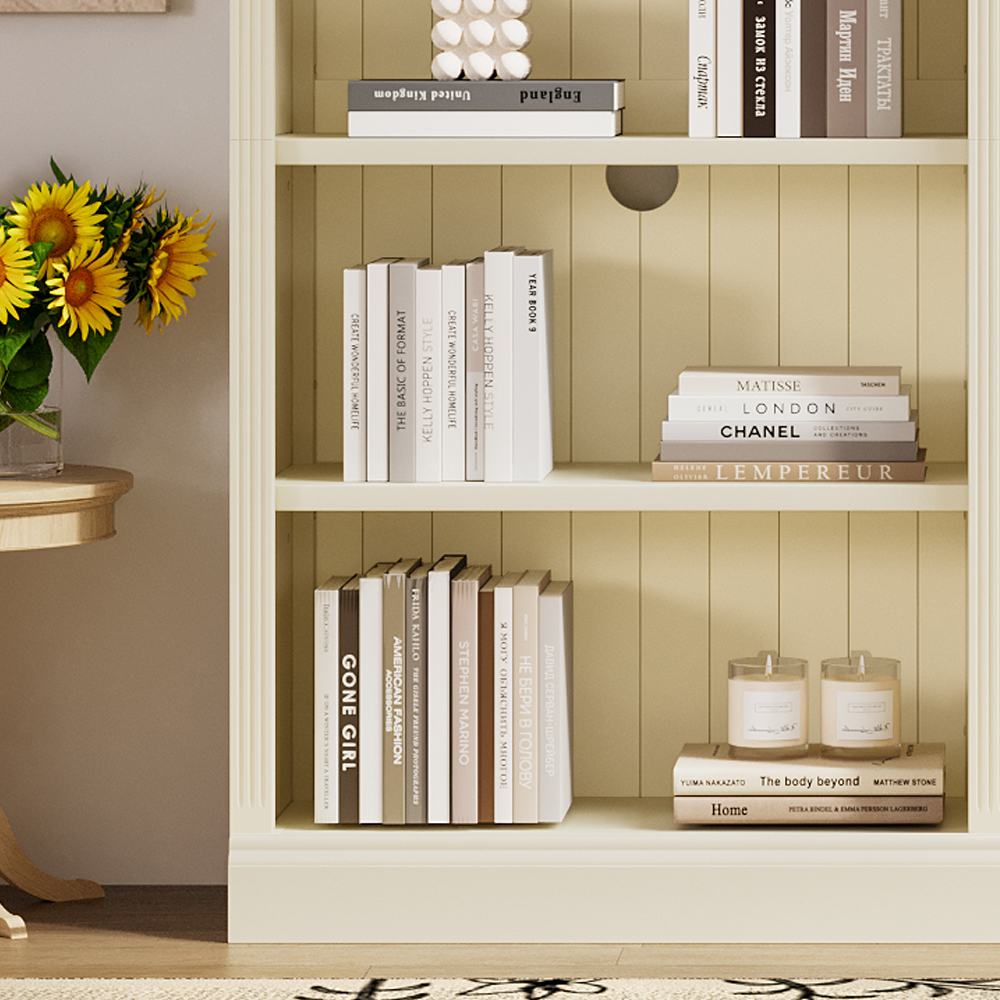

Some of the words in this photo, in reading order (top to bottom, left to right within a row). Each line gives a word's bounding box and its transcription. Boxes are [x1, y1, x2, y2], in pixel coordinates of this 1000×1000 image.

[836, 9, 857, 62] Мартин
[693, 55, 713, 109] Спартак
[837, 67, 857, 102] Иден
[877, 37, 892, 111] ТРАКТАТЫ
[374, 87, 427, 102] Kingdom
[430, 90, 471, 102] United
[519, 87, 582, 104] England
[528, 273, 537, 297] YEAR
[350, 313, 359, 342] CREATE
[447, 310, 456, 339] CREATE
[484, 294, 494, 333] KELLY
[528, 299, 537, 325] BOOK
[396, 310, 406, 355] FORMAT
[422, 318, 432, 352] STYLE
[350, 343, 359, 391] WONDERFUL
[396, 359, 406, 373] OF
[422, 356, 432, 404] HOPPEN
[447, 340, 456, 389] WONDERFUL
[484, 337, 494, 388] HOPPEN
[396, 377, 406, 408] BASIC
[736, 380, 801, 392] MATISSE
[350, 392, 359, 431] HOMELIFE
[396, 411, 406, 431] THE
[422, 407, 432, 443] KELLY
[447, 390, 456, 429] HOMELIFE
[484, 392, 494, 430] STYLE
[743, 403, 836, 415] LONDON
[720, 424, 800, 438] CHANEL
[715, 464, 893, 480] LEMPEREUR
[411, 588, 421, 621] FRIDA
[411, 623, 421, 662] KAHLO
[500, 632, 508, 664] МОГУ
[393, 635, 403, 705] AMERICAN
[458, 640, 470, 706] STEPHEN
[518, 655, 532, 675] НЕ
[543, 643, 555, 680] ДАВИД
[341, 653, 357, 716] GONE
[385, 668, 393, 732] ACCESSORIES
[500, 668, 508, 738] ОБЪЯСНИТЬ
[518, 677, 532, 714] БЕРИ
[393, 707, 403, 766] FASHION
[458, 708, 470, 766] MARINO
[518, 718, 532, 728] В
[341, 723, 357, 772] GIRL
[500, 740, 508, 790] МНОГОЕ
[518, 730, 532, 790] ГОЛОВУ
[760, 776, 781, 787] The
[784, 776, 814, 790] body
[816, 776, 860, 790] beyond
[711, 803, 749, 817] Home
